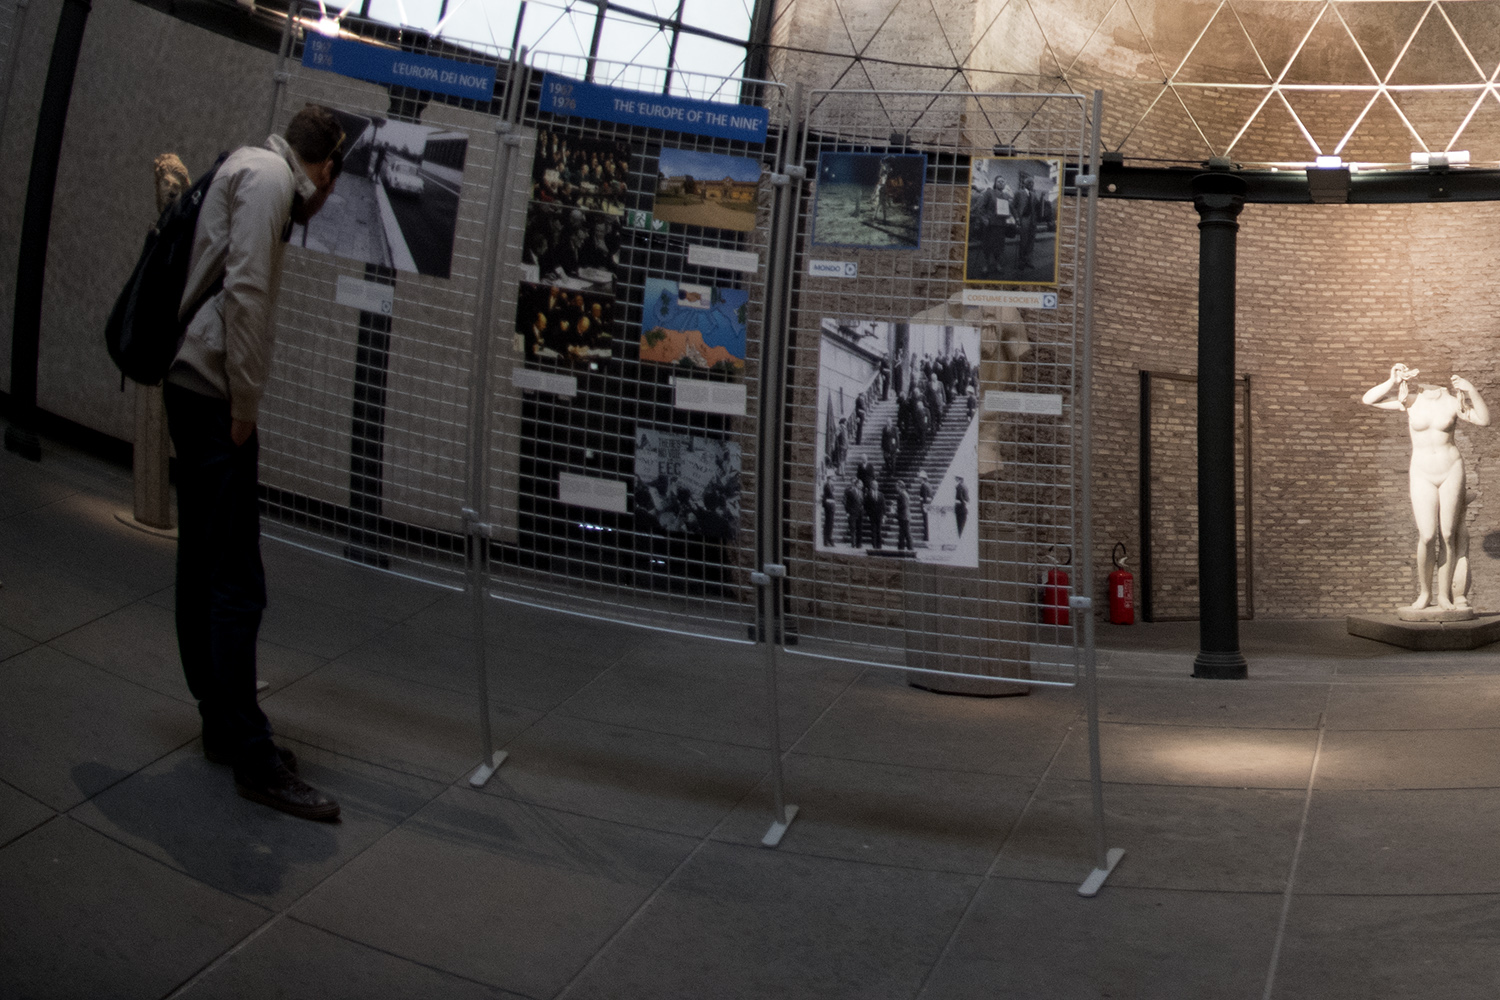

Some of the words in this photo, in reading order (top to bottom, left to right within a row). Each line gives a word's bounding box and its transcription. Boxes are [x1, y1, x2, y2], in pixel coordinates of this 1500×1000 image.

[392, 62, 438, 81] L'EUROPA
[440, 70, 457, 84] DEI
[459, 74, 488, 90] NOVE
[550, 82, 574, 96] 1967
[552, 96, 576, 110] 1976
[613, 98, 635, 113] THE
[686, 109, 703, 122] OF
[705, 111, 728, 126] THE
[814, 264, 841, 272] MONDO
[967, 294, 1002, 303] COSTUME
[658, 461, 681, 475] EEC
